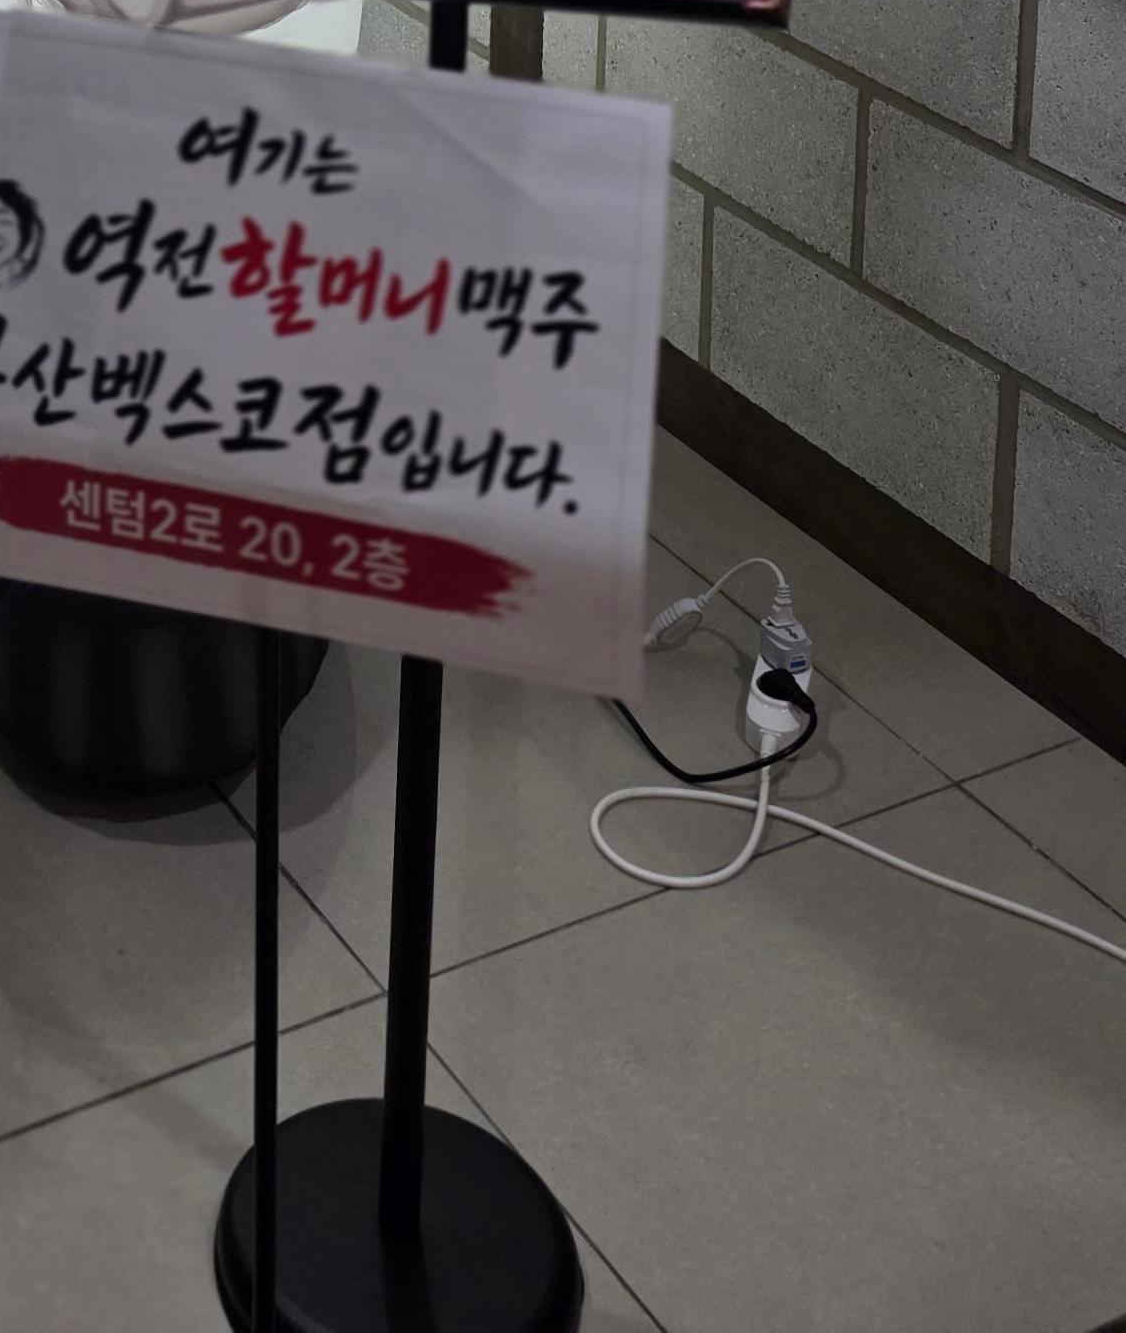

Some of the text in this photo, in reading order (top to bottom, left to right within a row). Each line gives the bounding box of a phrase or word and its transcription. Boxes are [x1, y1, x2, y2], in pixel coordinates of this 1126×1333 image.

[177, 107, 359, 195] 여기는
[62, 198, 600, 369] 역전할머니맥주
[59, 478, 409, 592] 센텀2로 20, 2층
